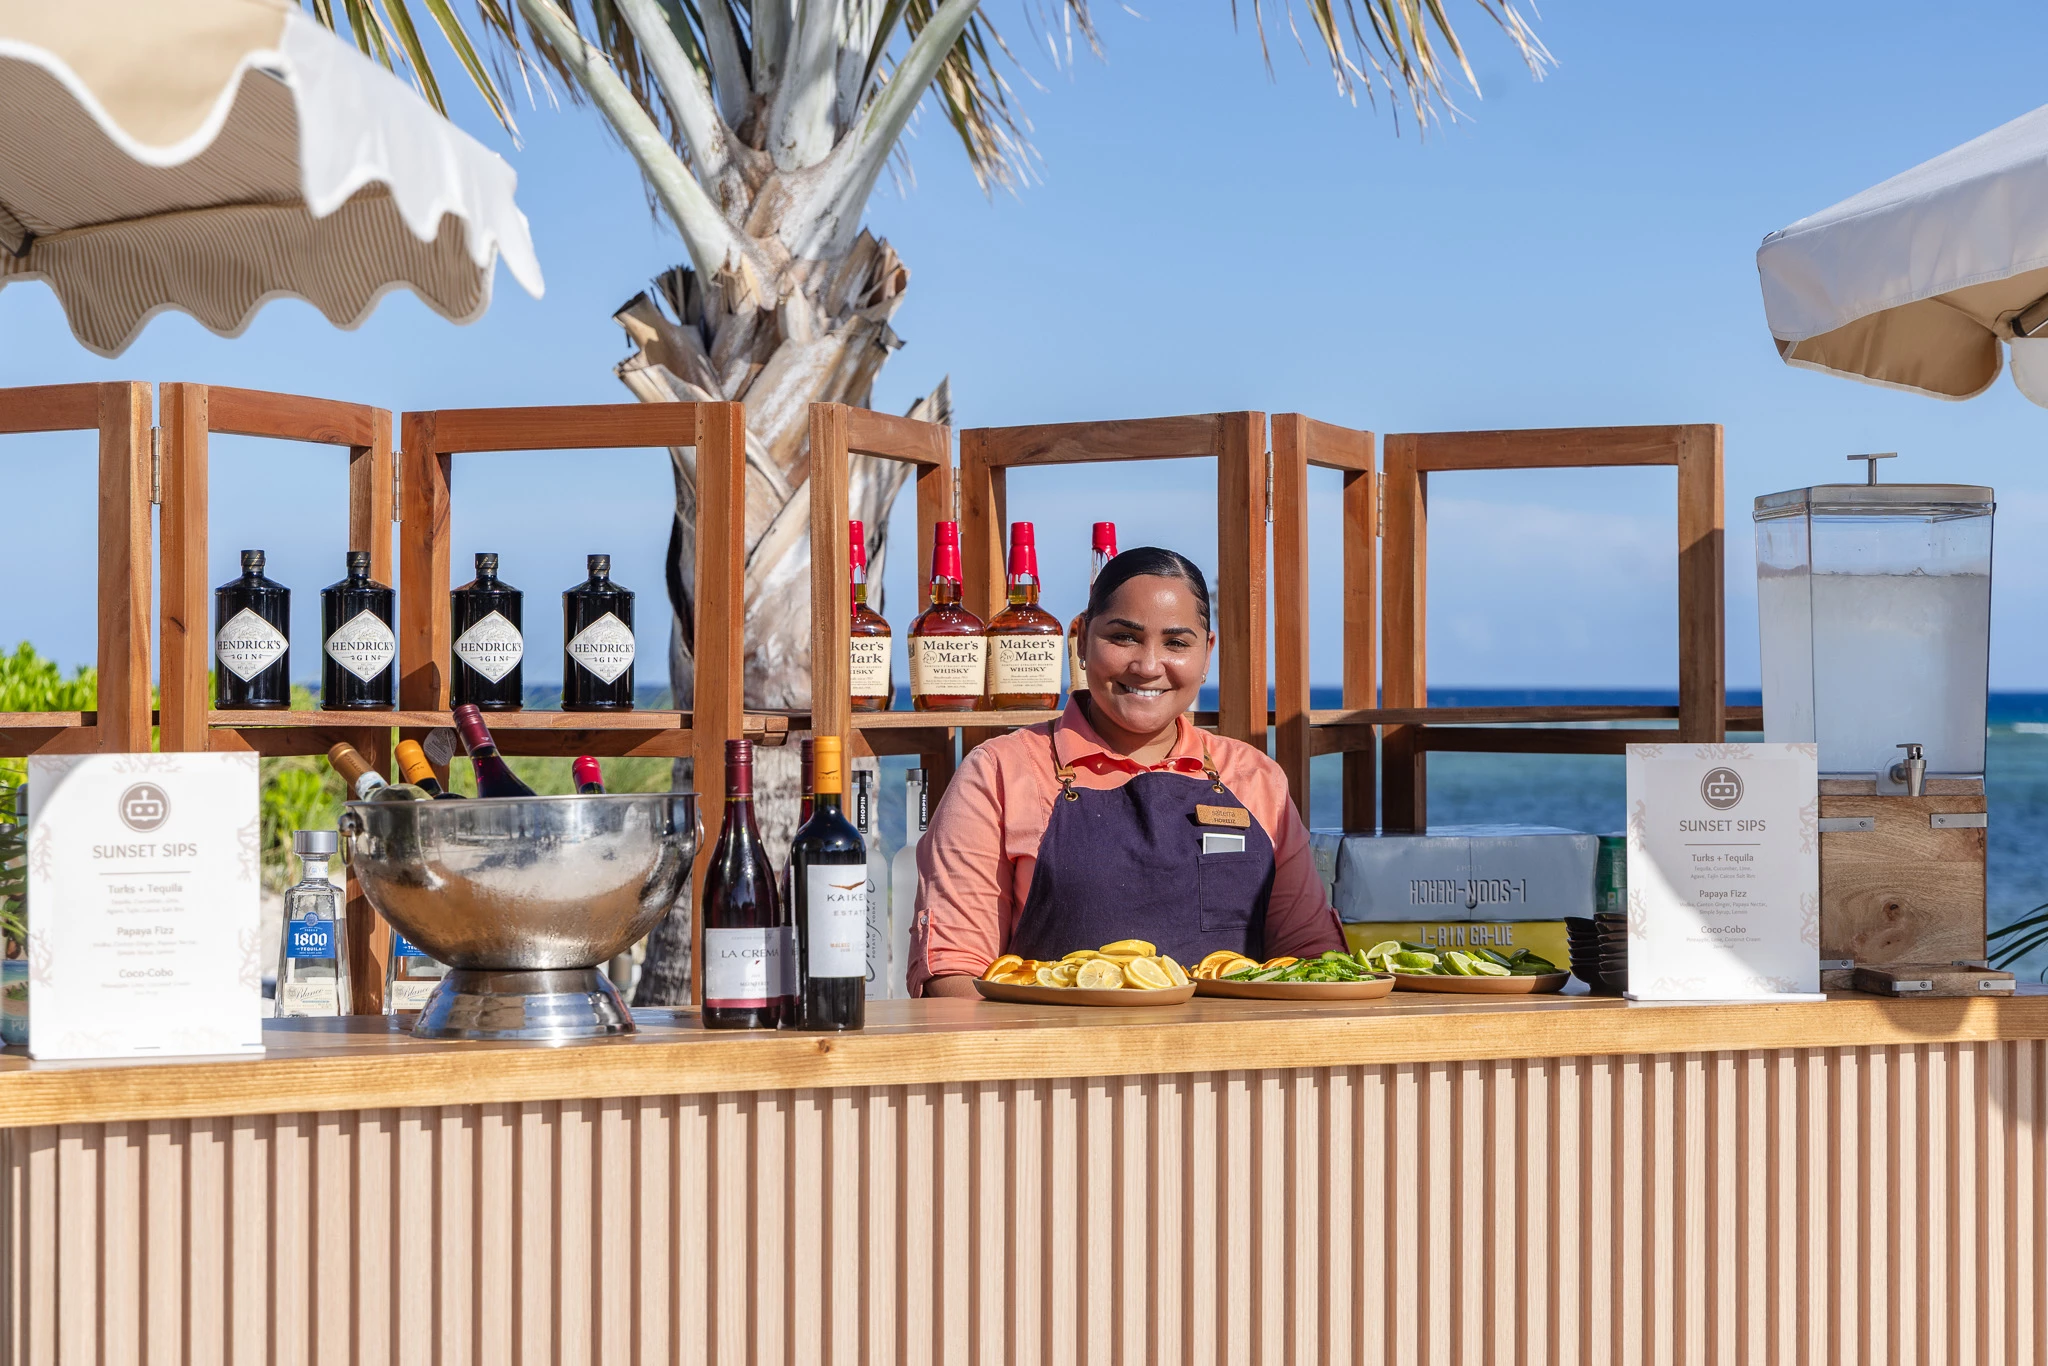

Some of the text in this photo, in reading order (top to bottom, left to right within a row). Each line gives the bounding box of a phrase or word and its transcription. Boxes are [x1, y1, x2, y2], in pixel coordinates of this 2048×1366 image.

[217, 640, 281, 650] HENDRICK'S
[332, 641, 394, 651] HENDRICK'S
[460, 642, 521, 652] HENDRICK'S
[574, 643, 633, 653] HENDRICK'S
[851, 641, 884, 651] ker's
[923, 640, 978, 650] Maker's
[1000, 639, 1055, 649] Maker's
[938, 652, 978, 663] Mark
[1015, 651, 1054, 661] Mark
[1679, 819, 1766, 832] SUNSET SIPS
[92, 843, 197, 859] SUNSET SIPS
[1692, 853, 1715, 862] Turks
[1724, 853, 1754, 864] Tequila
[107, 884, 136, 894] Turks
[147, 882, 183, 895] Tequila
[1699, 889, 1747, 900] Papaya Fizz
[116, 925, 174, 938] Papaya Fizz
[1701, 925, 1746, 934] Coco-Cobo
[294, 932, 328, 947] 1800
[1470, 925, 1513, 946] GA-LIE
[721, 948, 779, 958] LA CREMA
[119, 967, 174, 978] Coco-Cobo
